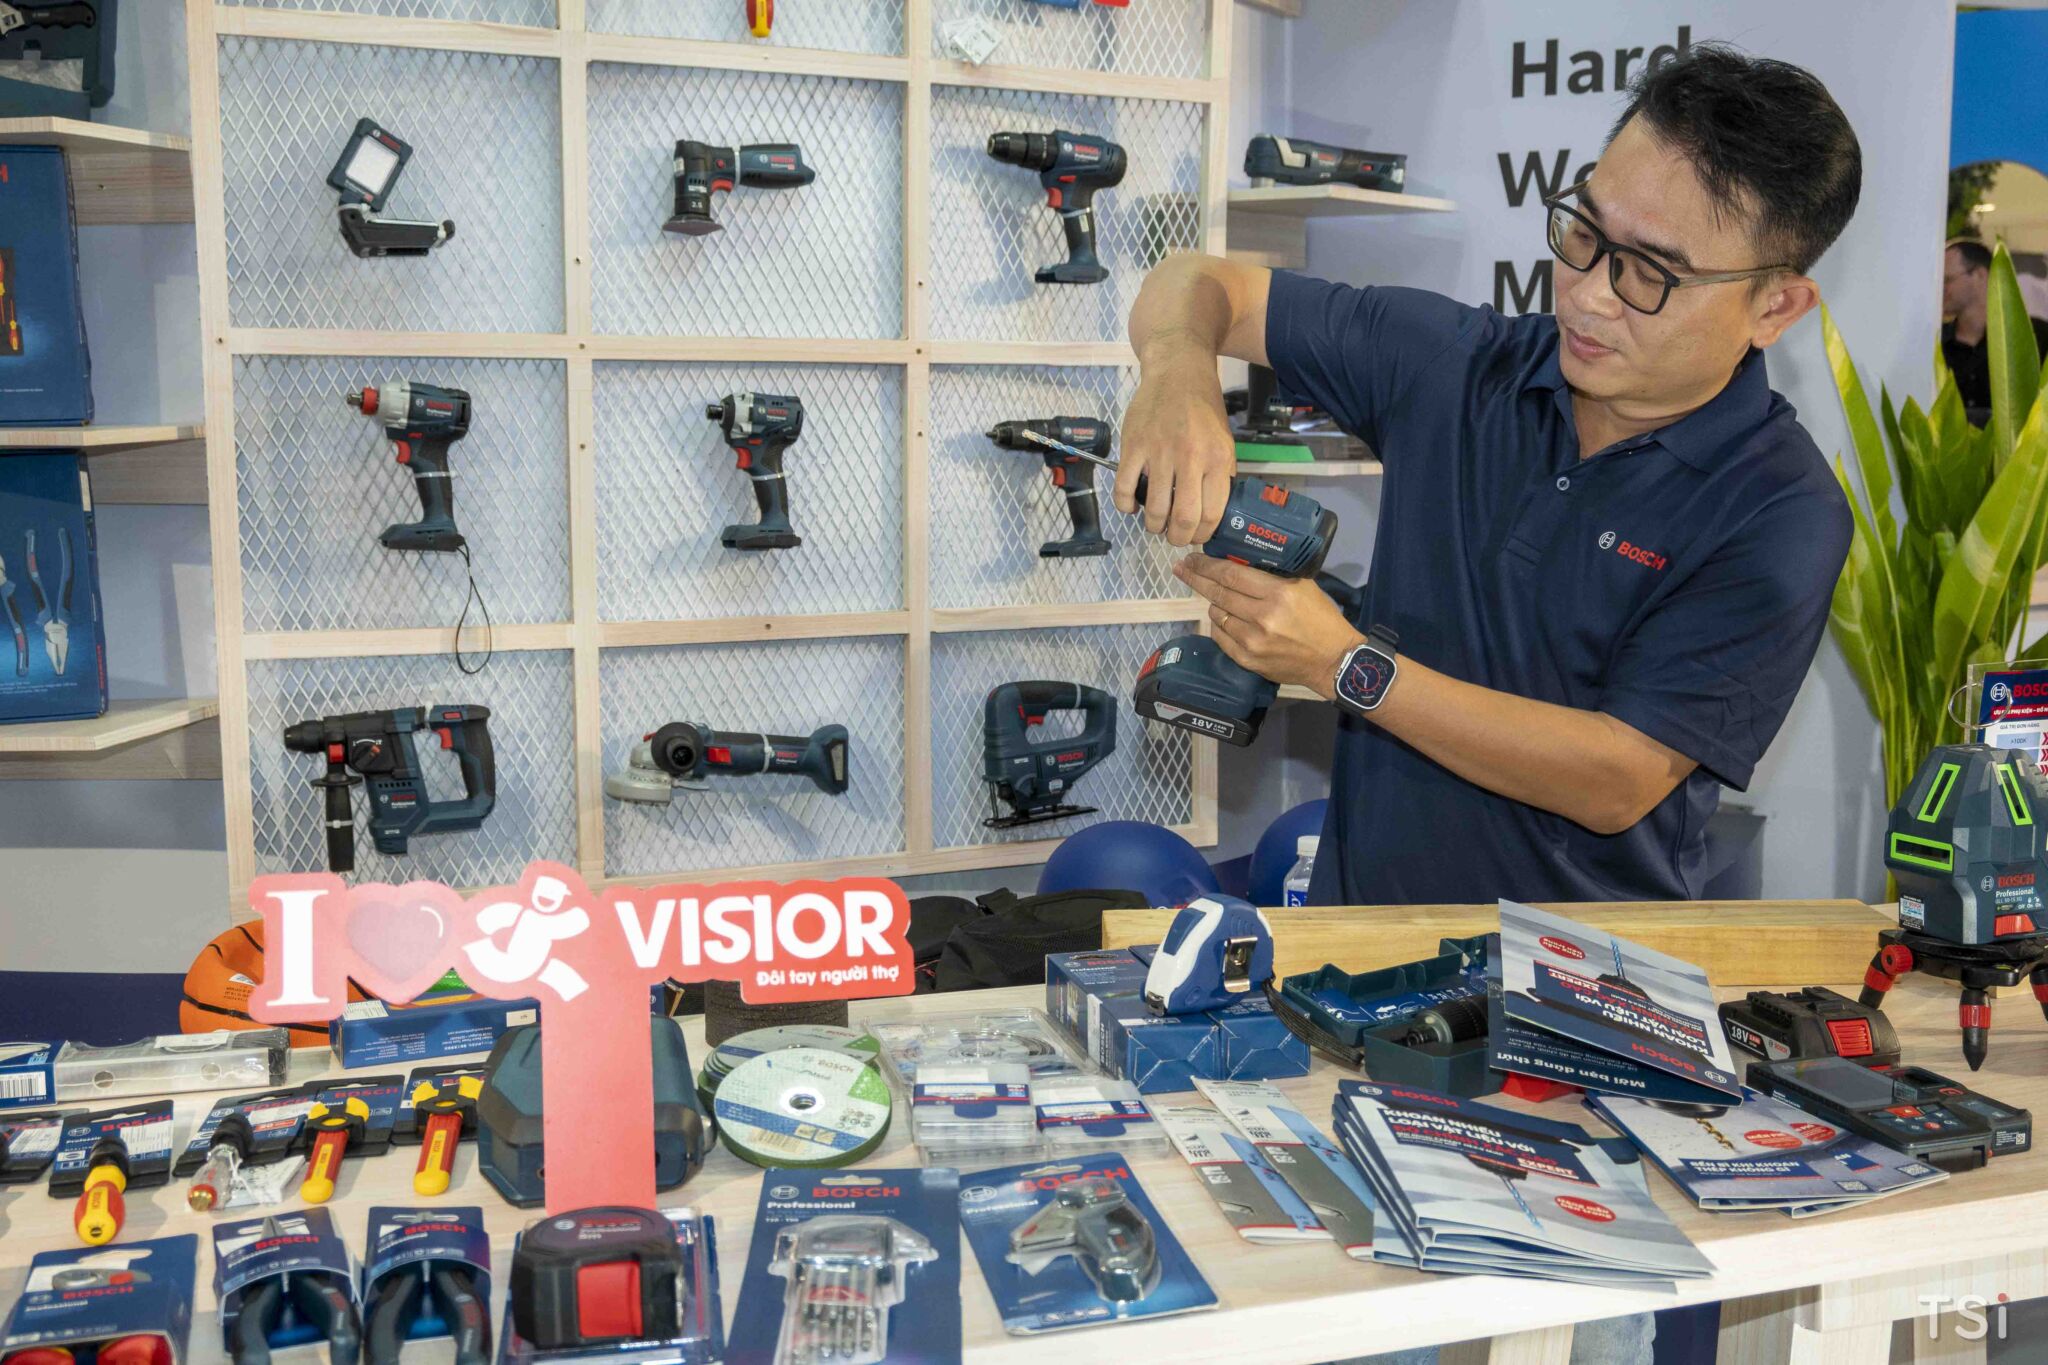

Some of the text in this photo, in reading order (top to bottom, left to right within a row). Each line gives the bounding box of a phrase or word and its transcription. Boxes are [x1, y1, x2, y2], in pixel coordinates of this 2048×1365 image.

[1247, 523, 1288, 544] BOSCH
[1244, 534, 1284, 552] Professional
[1616, 540, 1667, 570] BOSCH
[1191, 717, 1213, 730] 18V
[1995, 886, 2034, 898] Professional
[613, 889, 897, 968] VISIOR
[265, 889, 330, 1007] I
[756, 964, 900, 987] Đôi tay người thợ
[1548, 970, 1600, 993] EXPERT
[1573, 992, 1708, 1047] LOẠI VẬT LIỆU VỚI
[1651, 1027, 1711, 1056] KHOAN
[1731, 1025, 1749, 1043] 18V
[817, 1058, 855, 1073] BOSCH
[1533, 1058, 1575, 1074] dùng
[1629, 1041, 1698, 1074] BOSCH
[1579, 1068, 1609, 1083] bạn
[334, 1087, 399, 1099] BOSCH
[1391, 1089, 1460, 1108] BOSCH
[101, 1114, 172, 1132] BOSCH
[1384, 1108, 1445, 1124] KHOAN
[1516, 1157, 1574, 1176] EXPERT
[812, 1186, 900, 1198] BOSCH
[767, 1201, 856, 1209] Professional
[403, 1221, 468, 1236] BOSCH
[255, 1235, 320, 1250] BOSCH
[62, 1286, 134, 1300] BOSCH
